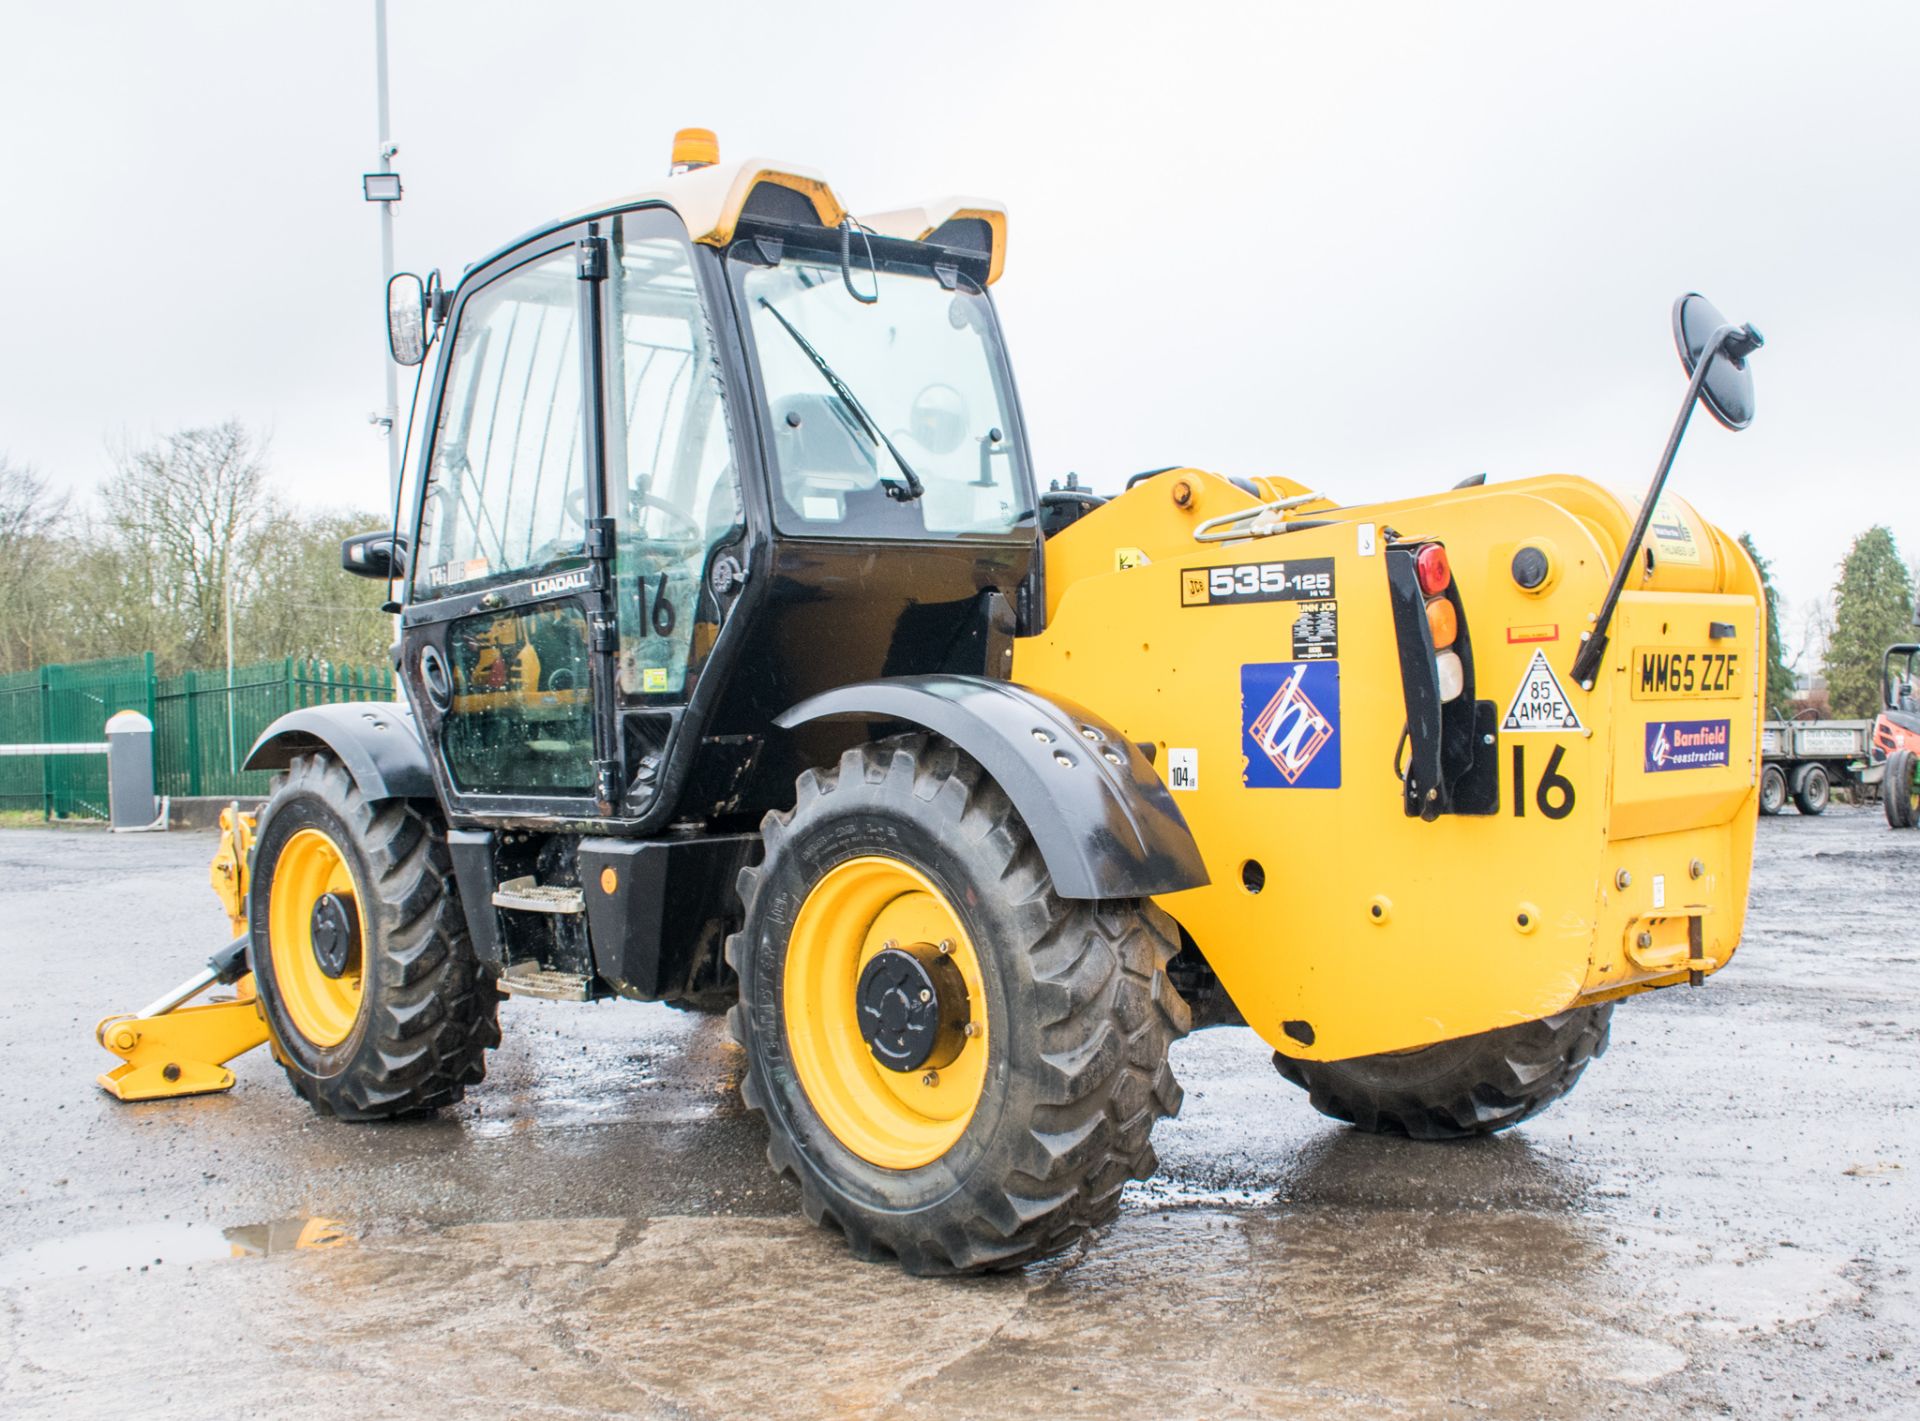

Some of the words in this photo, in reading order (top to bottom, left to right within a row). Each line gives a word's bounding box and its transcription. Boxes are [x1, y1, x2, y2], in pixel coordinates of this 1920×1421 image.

[531, 573, 589, 597] LOADALL
[1209, 563, 1331, 596] 535-125
[637, 572, 676, 638] 16
[1319, 602, 1336, 611] JCB
[1641, 653, 1696, 692] MM65
[1701, 653, 1738, 691] ZZF
[1531, 681, 1550, 700] 85
[1520, 702, 1563, 720] AM9E
[1673, 725, 1726, 747] Barnfield
[1673, 749, 1725, 764] construction
[1172, 766, 1189, 787] 104
[1513, 743, 1576, 821] 16
